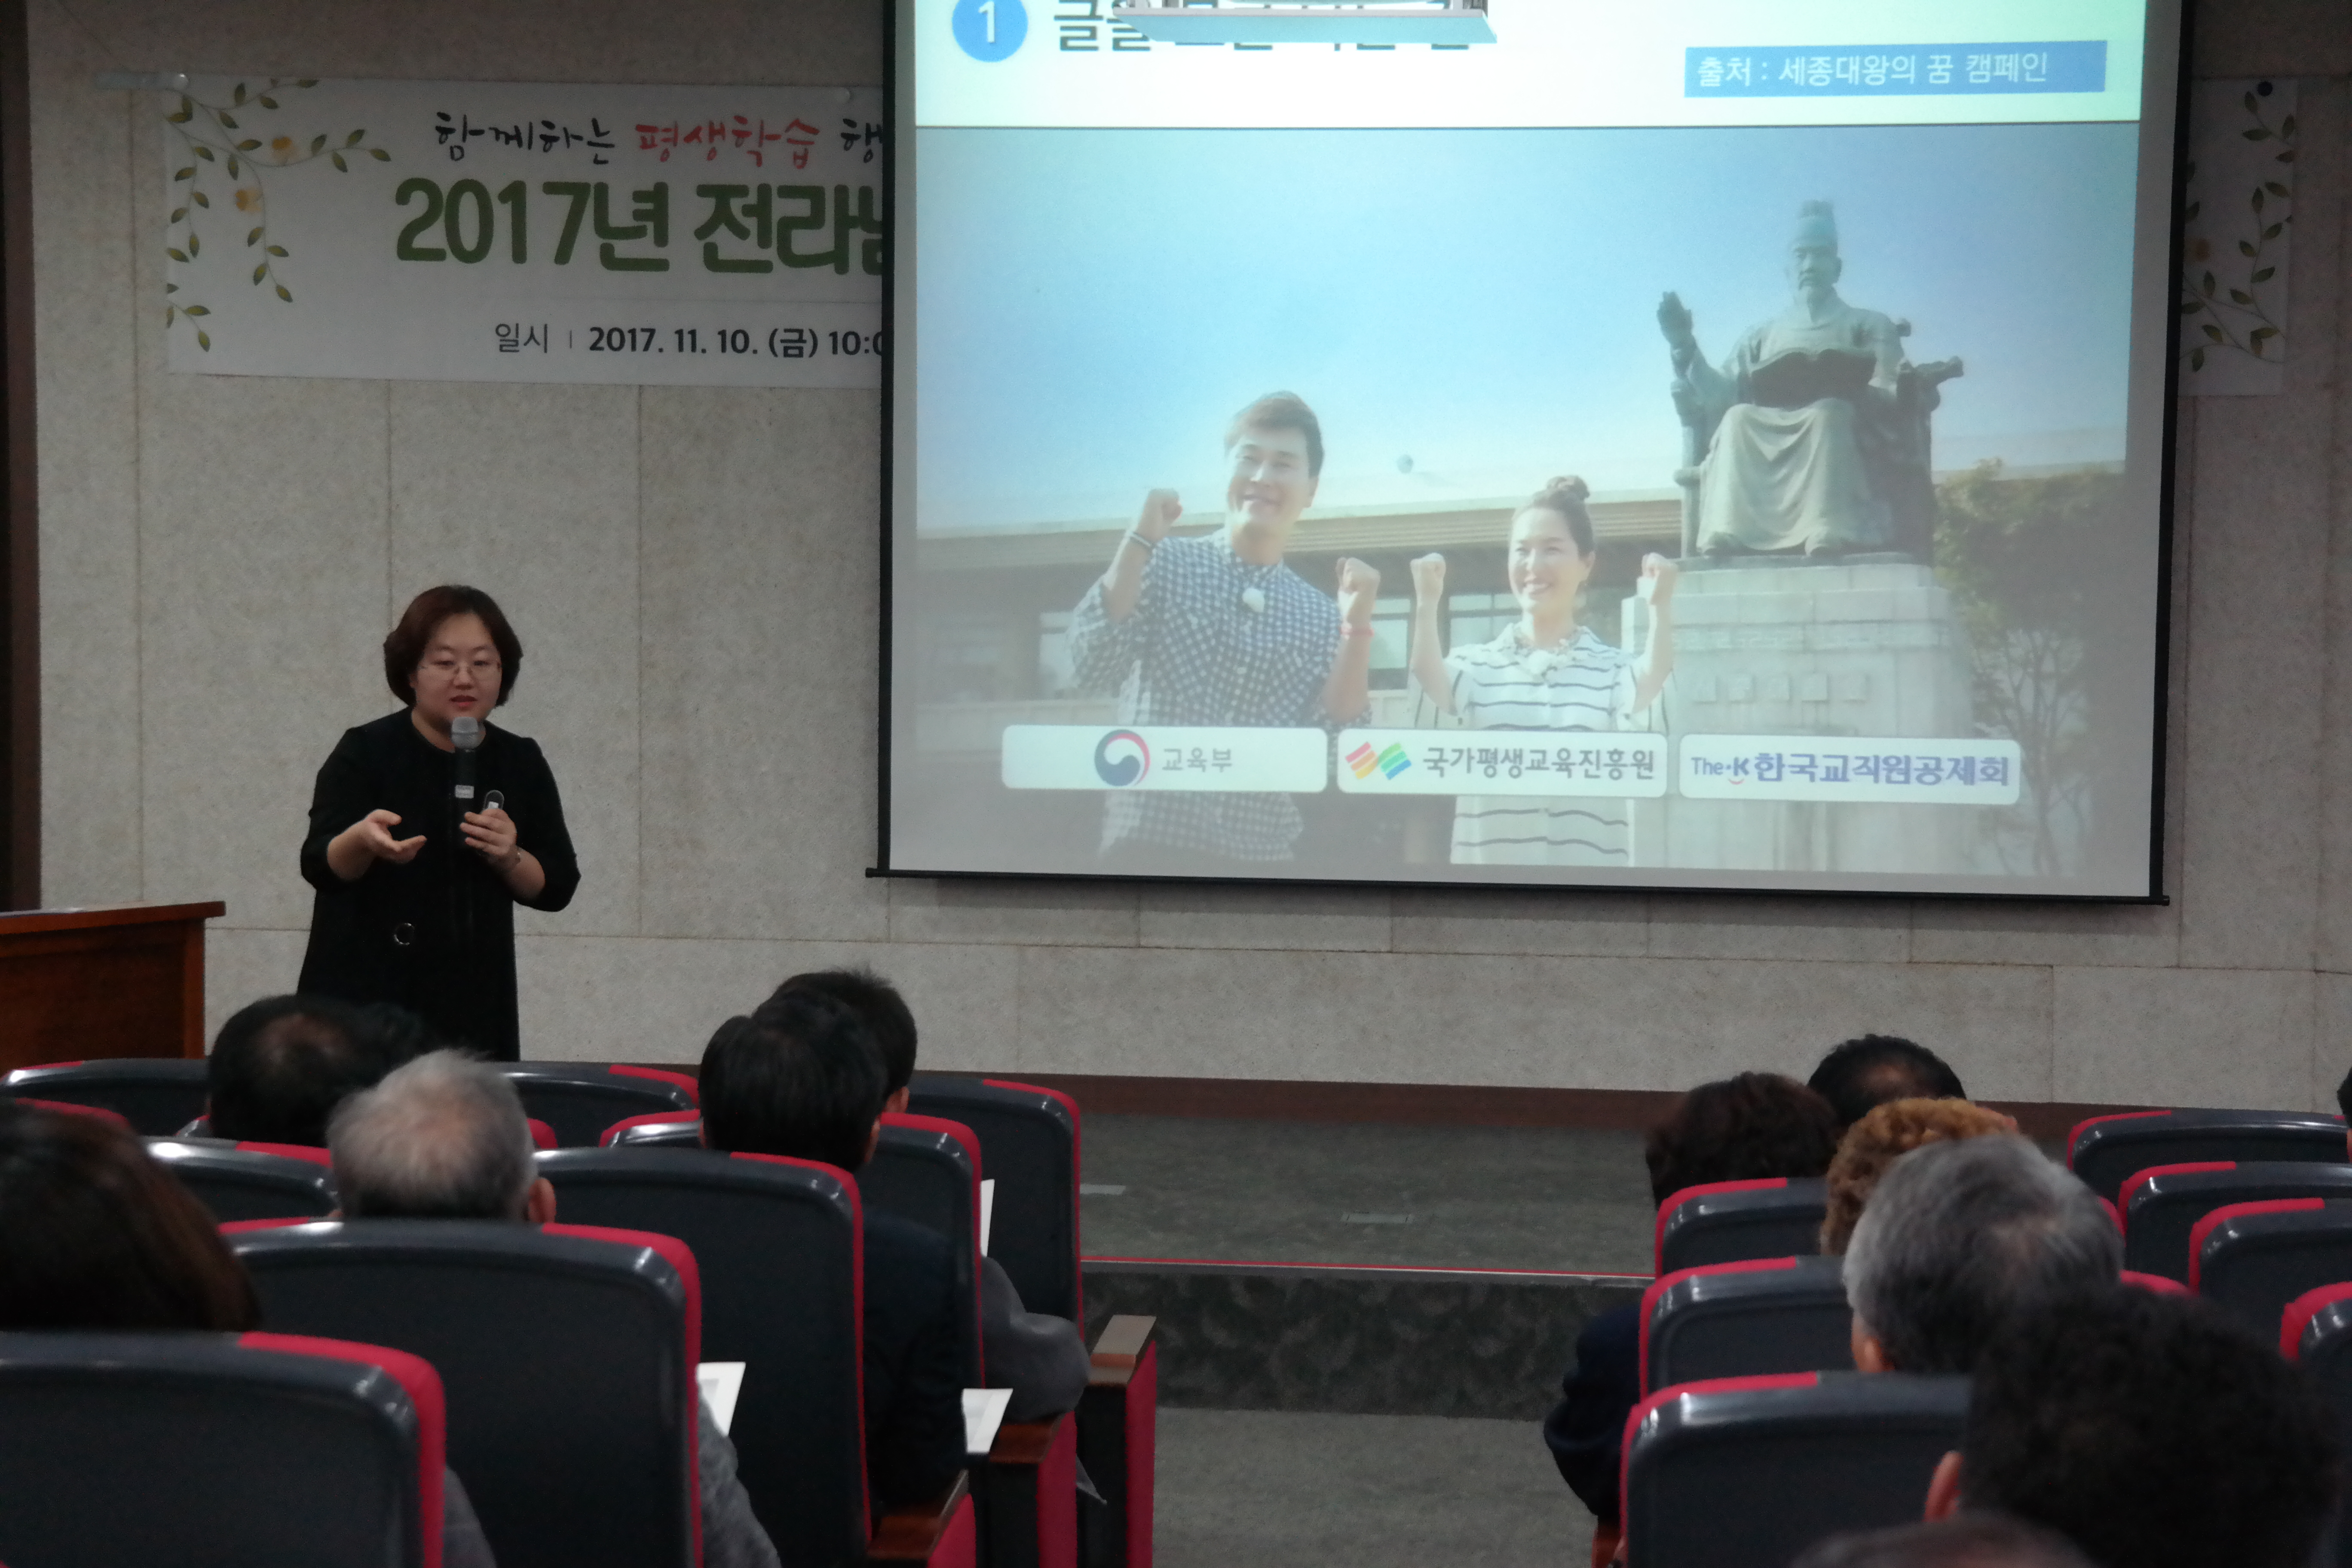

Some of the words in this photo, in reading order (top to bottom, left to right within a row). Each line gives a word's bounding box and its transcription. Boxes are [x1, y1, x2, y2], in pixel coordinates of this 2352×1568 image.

[978, 0, 995, 43] 1
[1697, 56, 1751, 87] 출처
[1779, 55, 1915, 87] 세종대왕의
[1926, 55, 1954, 84] 꿈
[1966, 52, 2048, 84] 캠페인
[435, 111, 615, 165] 함께하는
[634, 115, 820, 169] 평생학습
[395, 177, 670, 272] 2017년
[495, 323, 548, 354] 일시
[1162, 747, 1233, 773] 교육부
[1423, 747, 1654, 781] 국가평생교육진흥원
[1754, 753, 2009, 787] 한국교직원공제회
